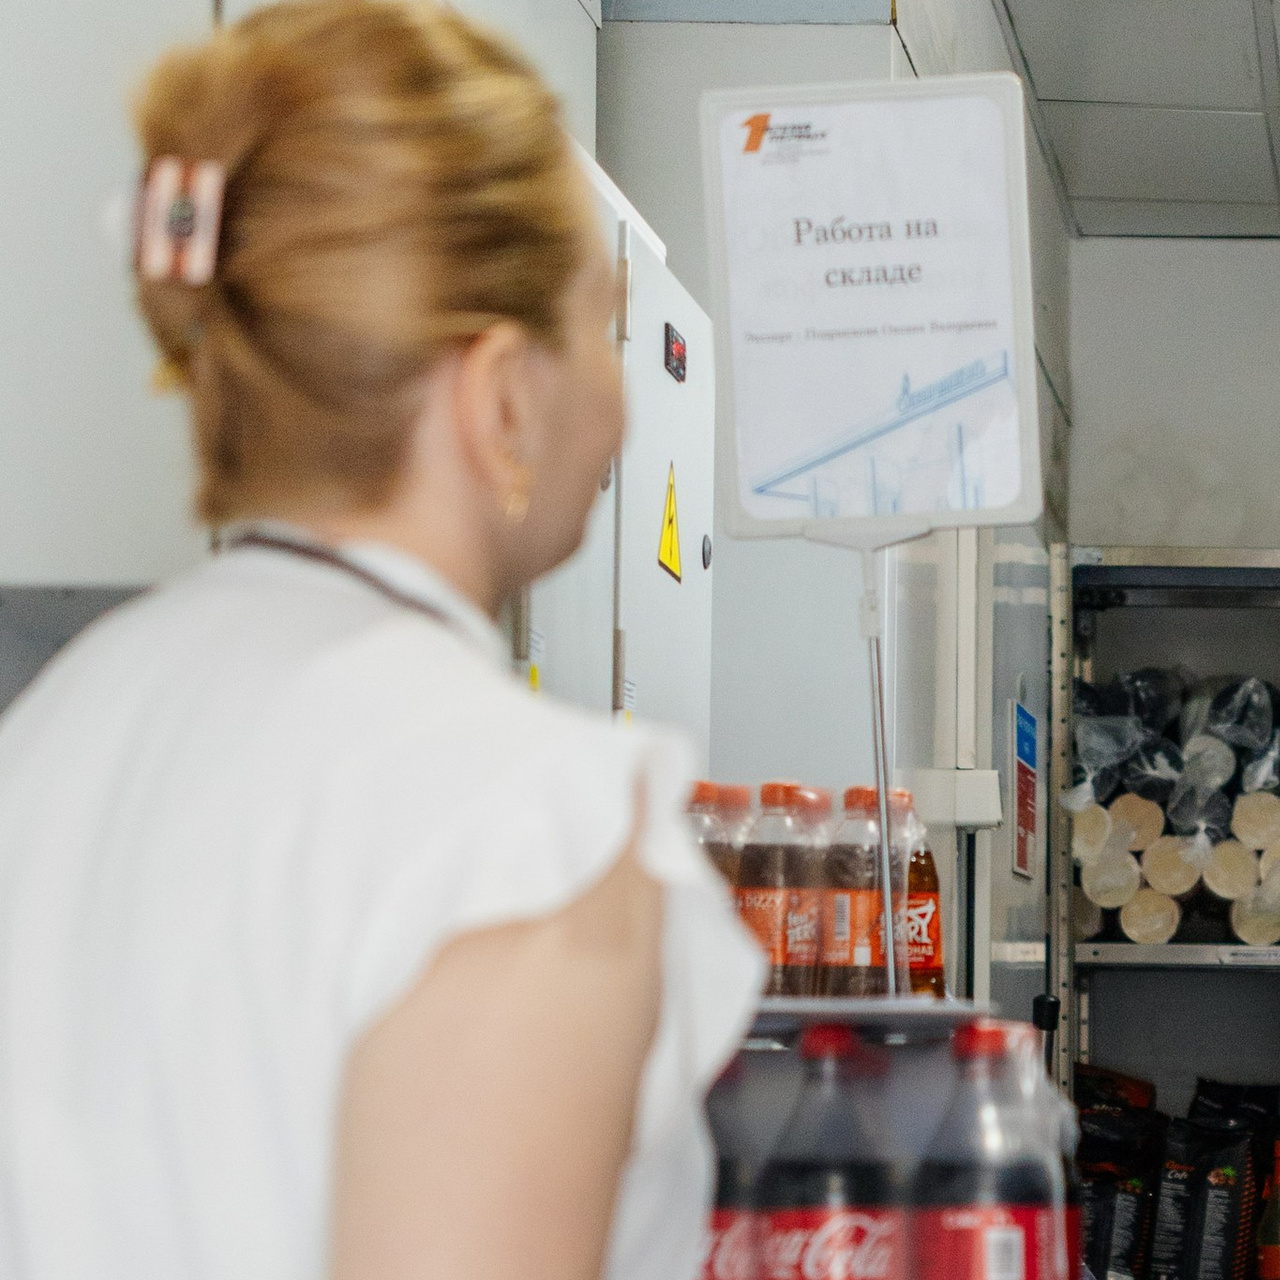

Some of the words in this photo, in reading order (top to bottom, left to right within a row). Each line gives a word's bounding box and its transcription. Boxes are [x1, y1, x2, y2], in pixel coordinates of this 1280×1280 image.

[793, 215, 893, 246] Работа
[905, 217, 939, 240] на
[824, 262, 923, 288] складе
